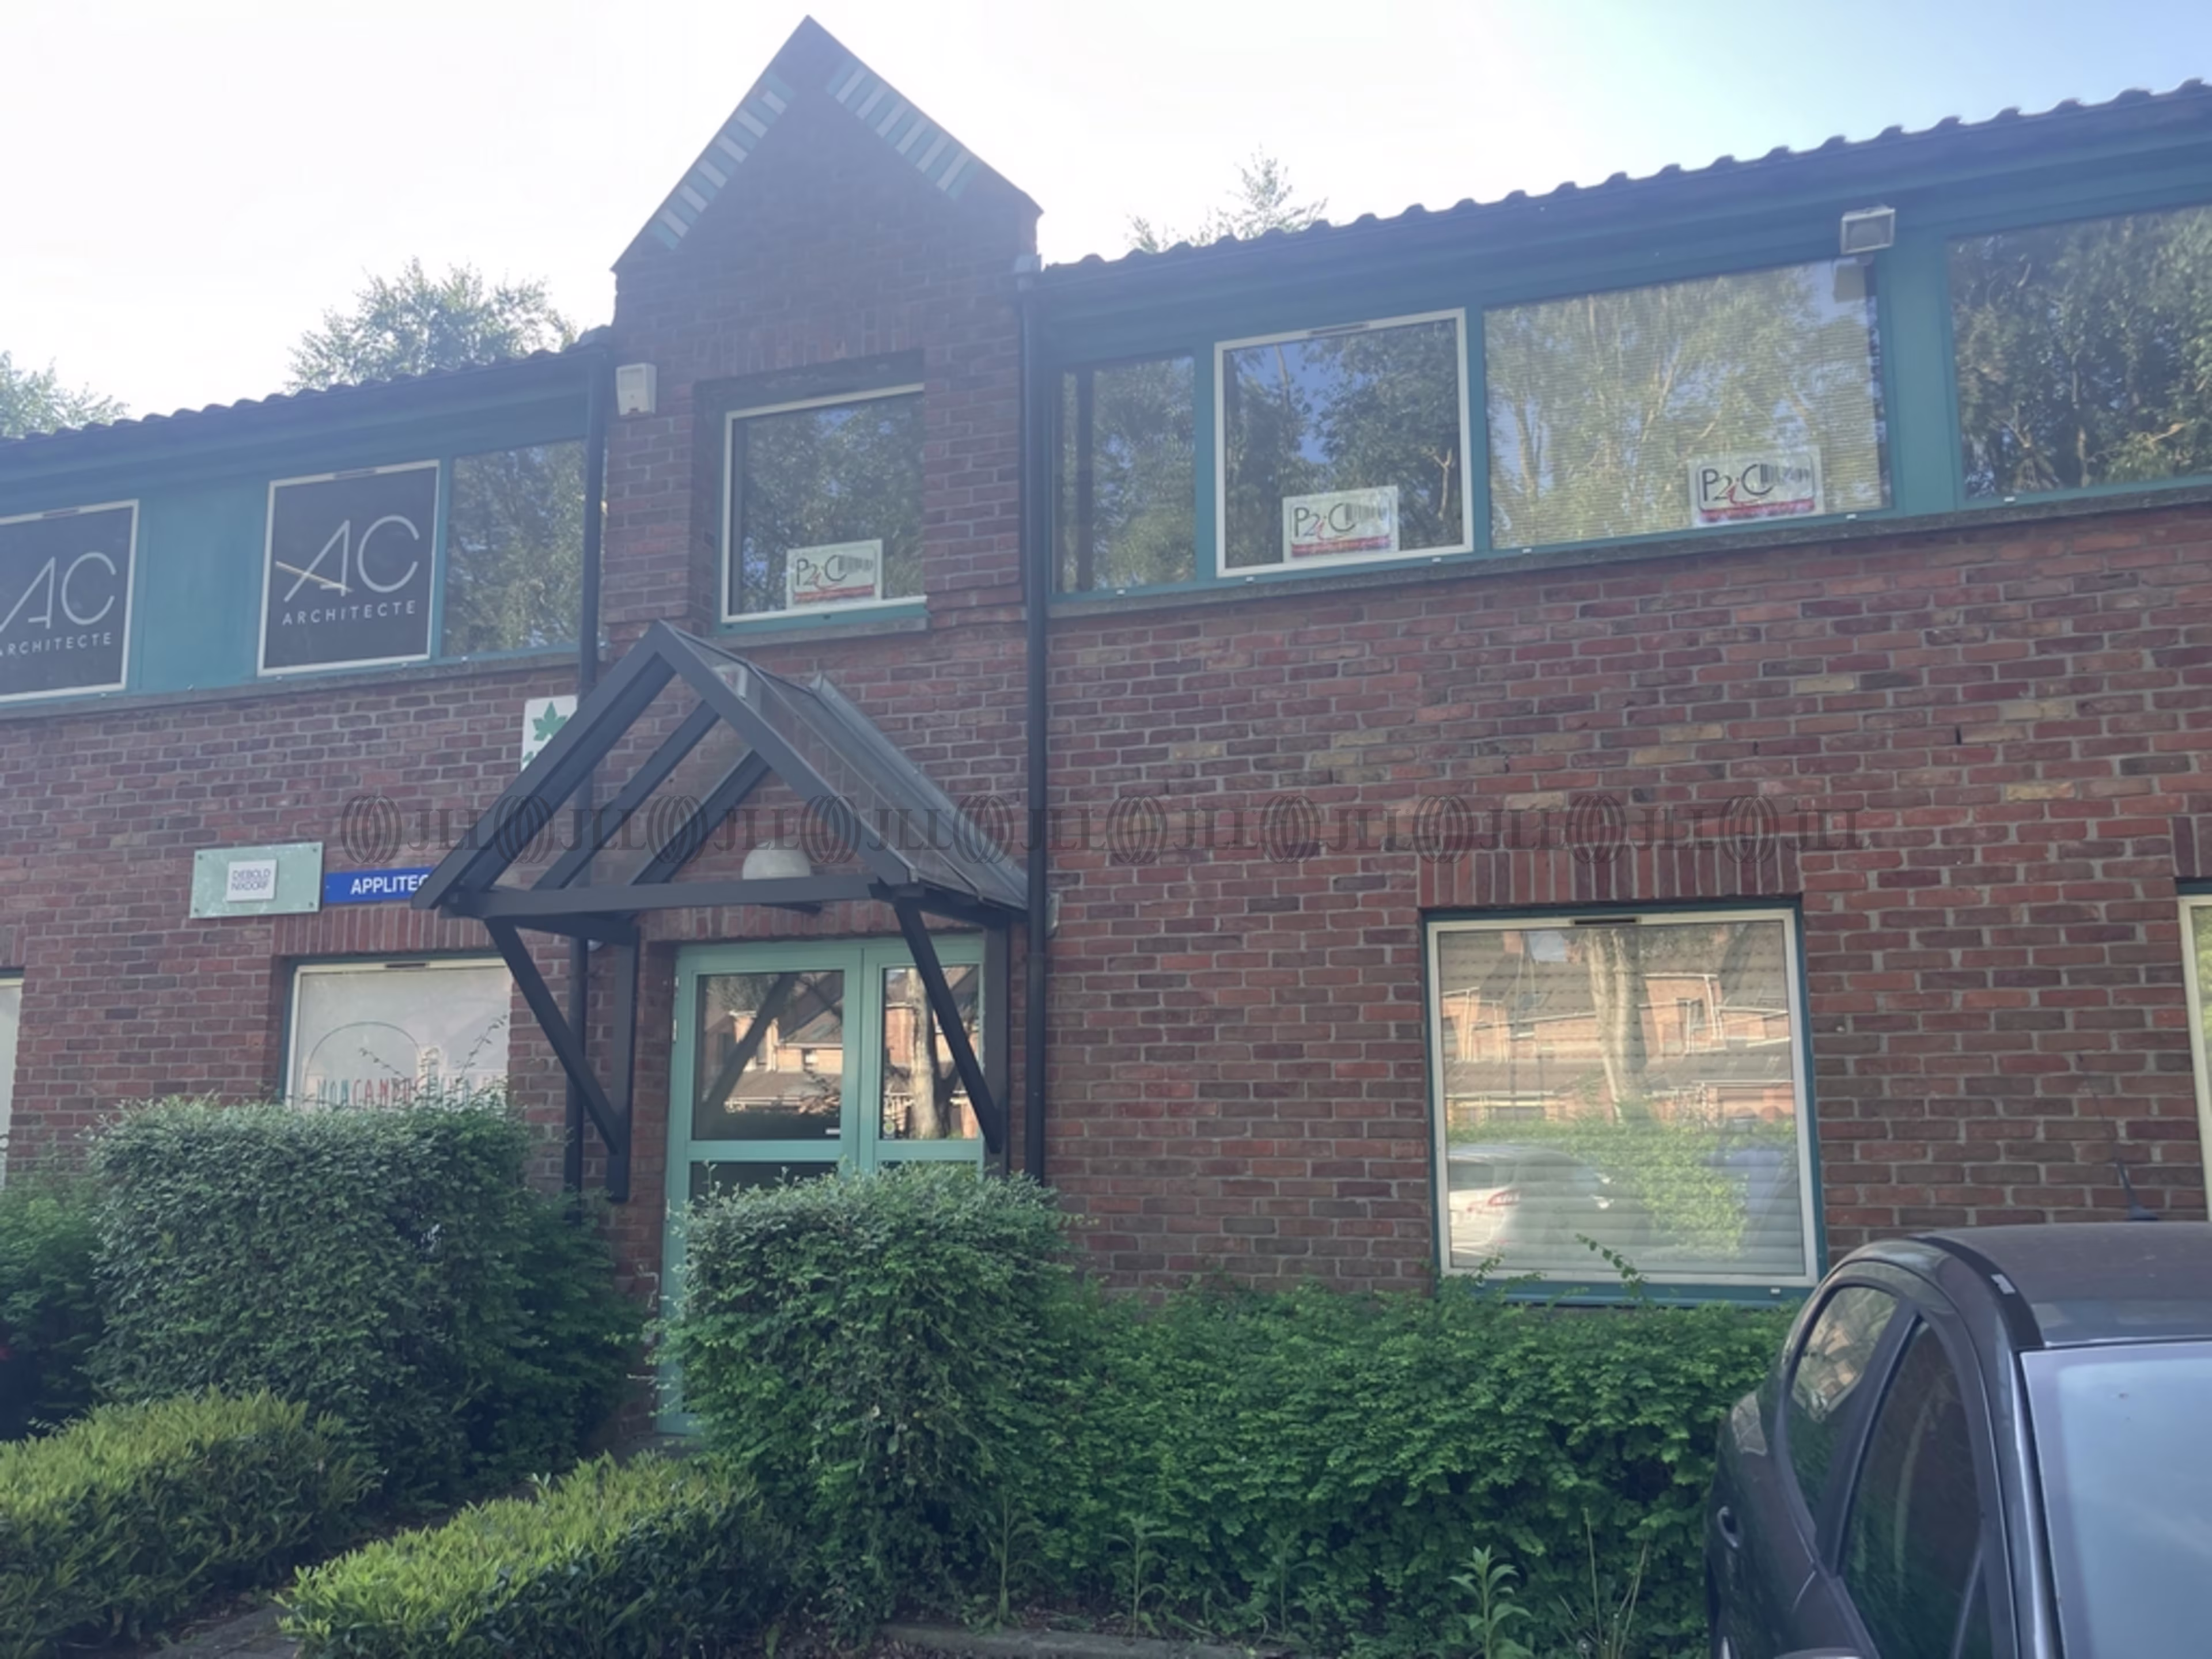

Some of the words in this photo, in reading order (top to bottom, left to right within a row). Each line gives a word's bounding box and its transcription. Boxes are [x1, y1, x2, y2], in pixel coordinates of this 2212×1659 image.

[0, 551, 116, 632] AC
[285, 514, 419, 601] AC
[282, 600, 415, 625] ARCHITECTE
